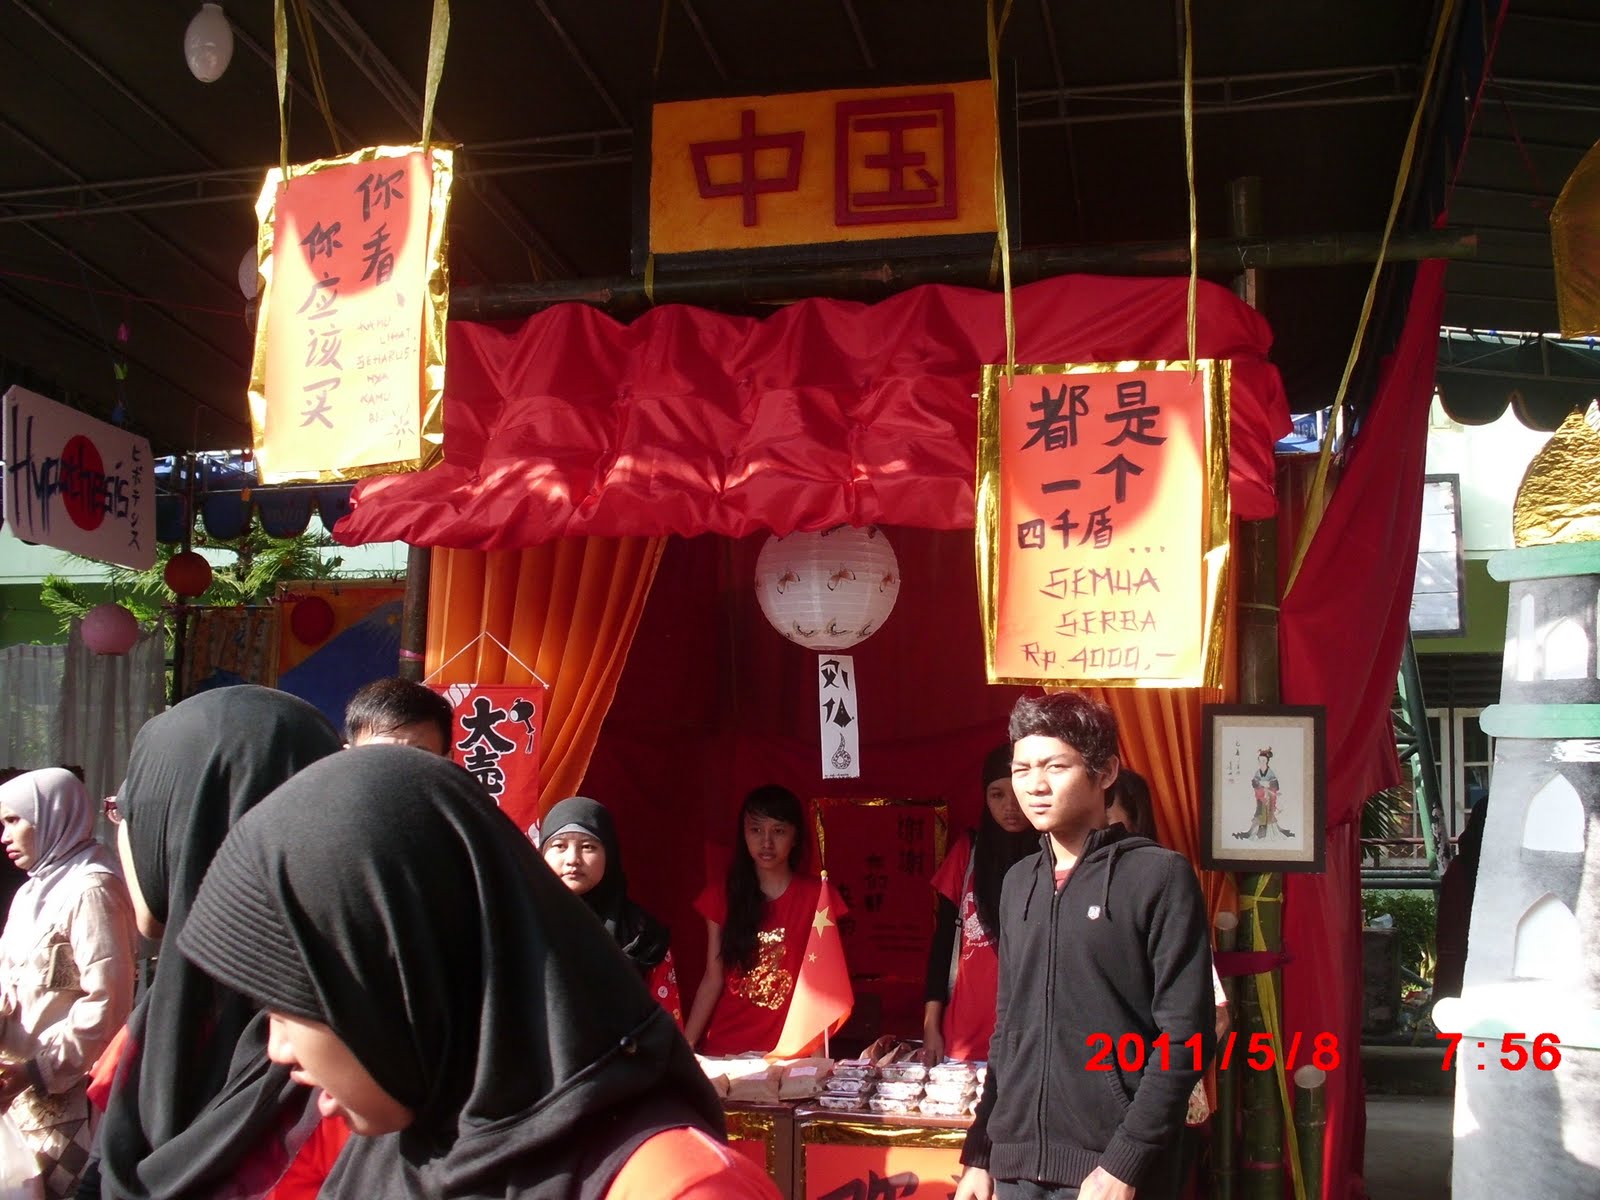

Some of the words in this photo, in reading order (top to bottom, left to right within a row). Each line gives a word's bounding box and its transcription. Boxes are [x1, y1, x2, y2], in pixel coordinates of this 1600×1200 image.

[689, 92, 957, 227] 中国
[296, 221, 343, 429] 你应该买
[1020, 381, 1168, 451] 都是
[1041, 453, 1144, 503] 一个
[1040, 568, 1160, 599] SEMUA
[1056, 610, 1157, 637] SERBA
